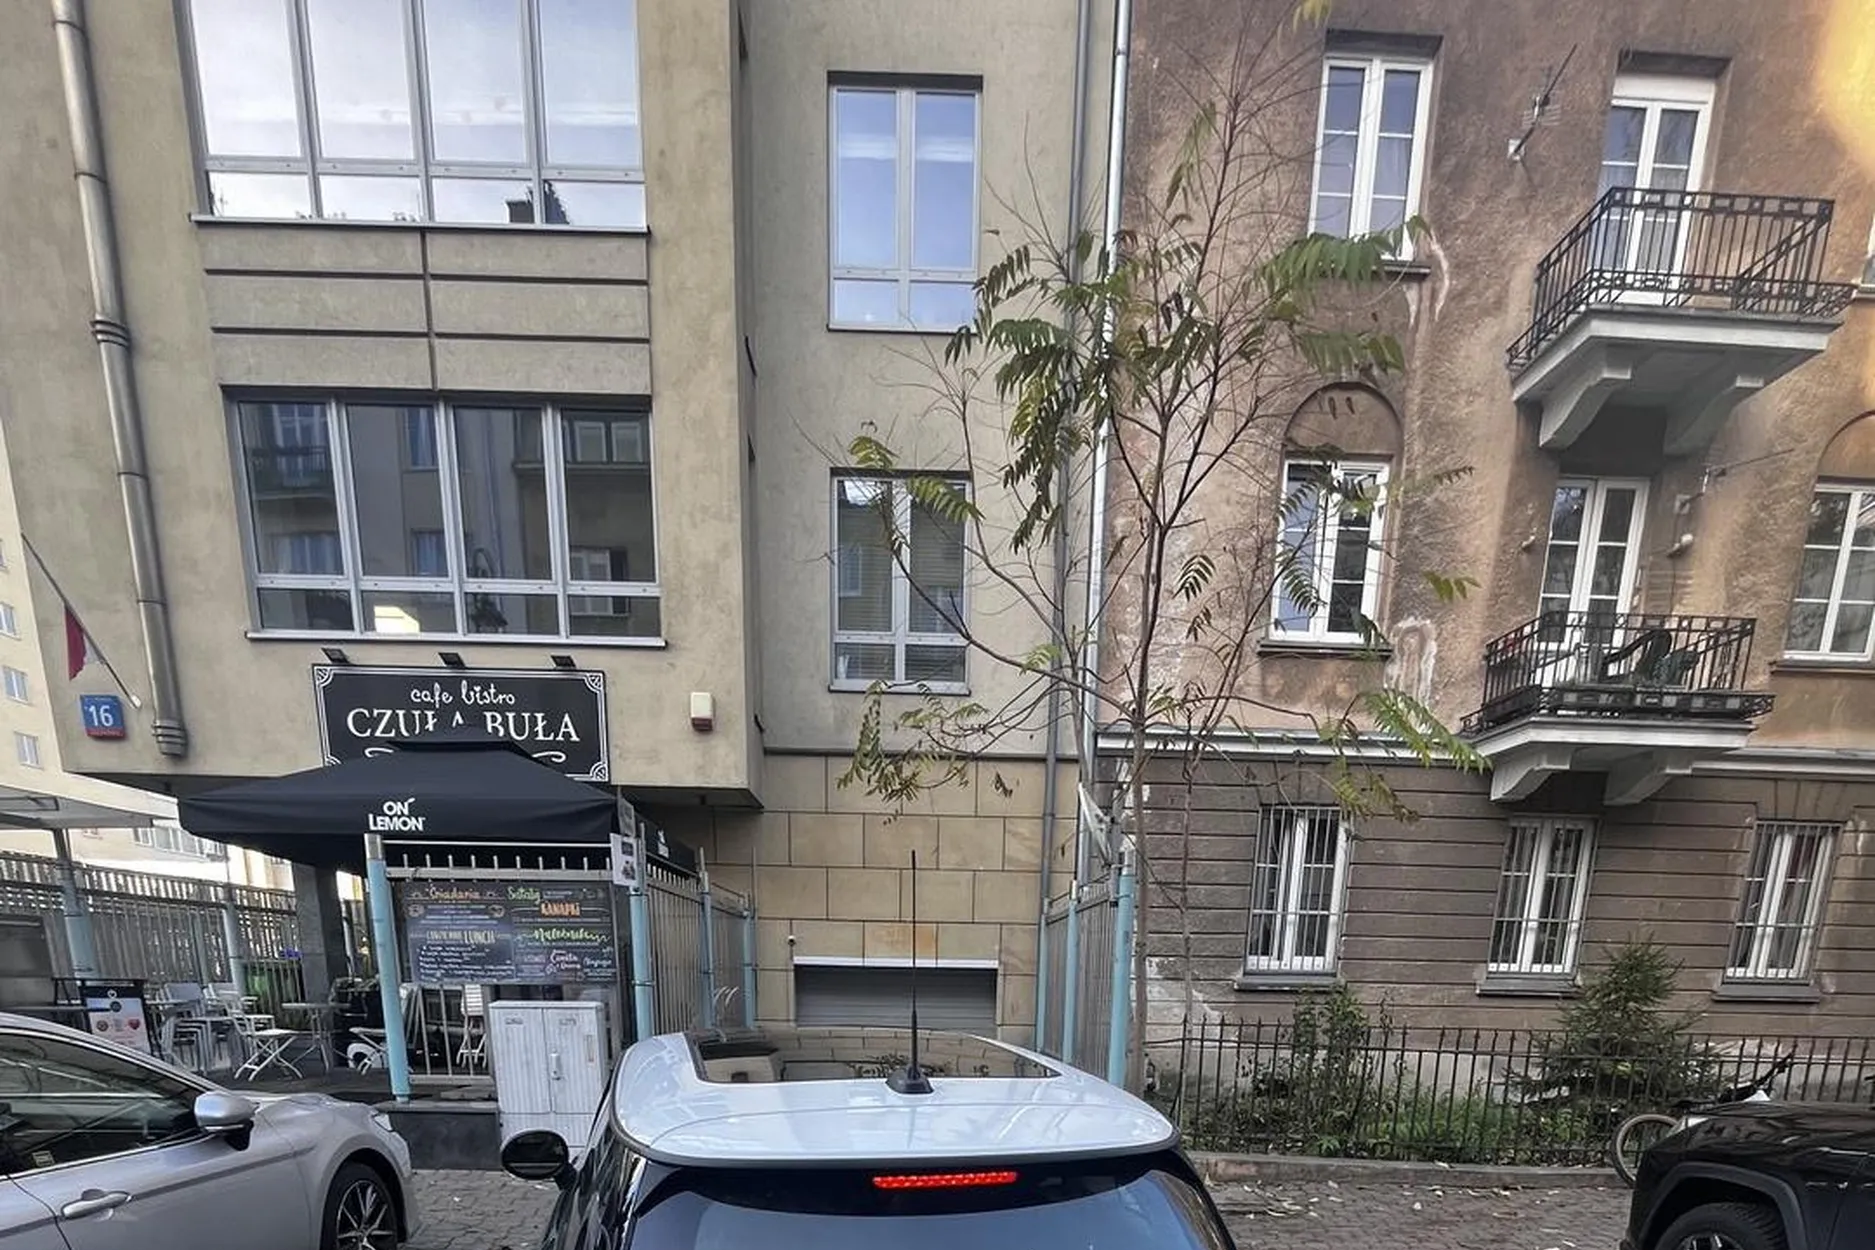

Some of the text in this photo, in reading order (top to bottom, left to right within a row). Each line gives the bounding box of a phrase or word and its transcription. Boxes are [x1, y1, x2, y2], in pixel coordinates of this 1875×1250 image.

[410, 680, 516, 708] cafe bistro
[89, 704, 114, 727] 16
[483, 711, 580, 742] BUŁA
[383, 798, 415, 815] ON
[368, 813, 426, 831] LEMON
